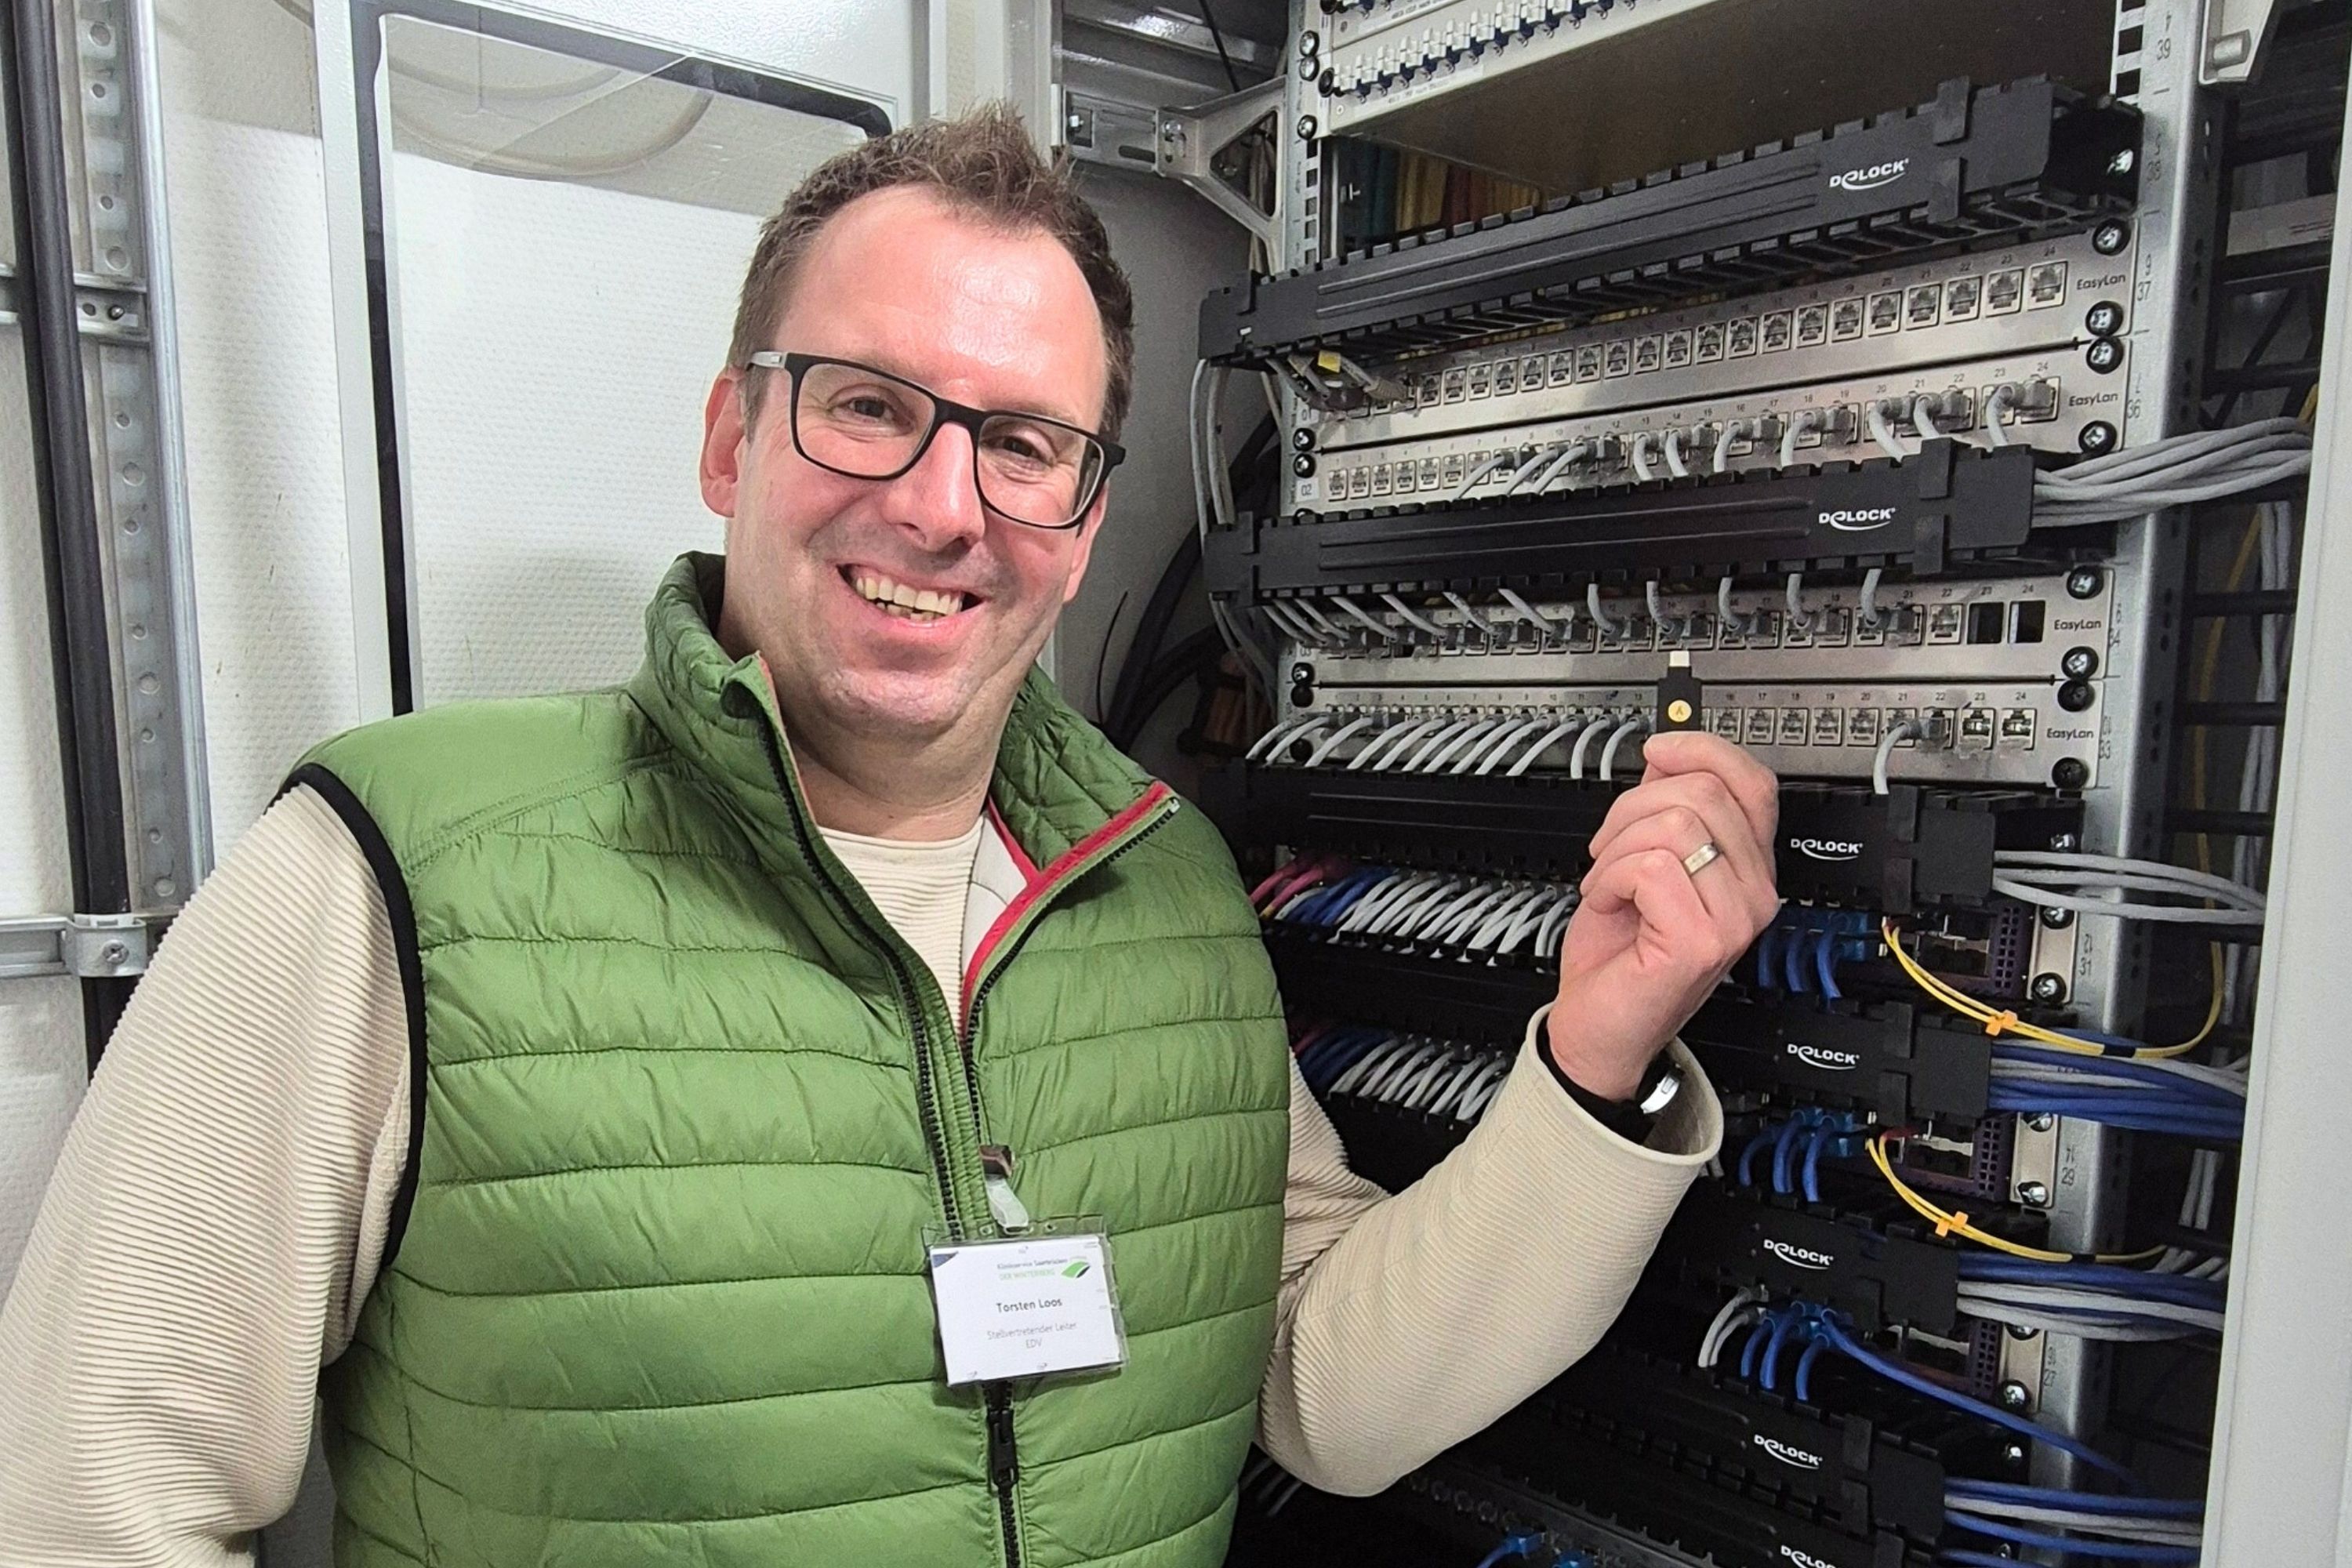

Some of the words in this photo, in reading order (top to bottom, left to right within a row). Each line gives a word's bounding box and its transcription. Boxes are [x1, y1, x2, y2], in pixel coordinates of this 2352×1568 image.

[2076, 274, 2126, 290] EasyLan
[2136, 280, 2152, 302] 37
[1915, 378, 1925, 388] 21
[1953, 373, 1965, 383] 22
[1994, 368, 2006, 378] 23
[2037, 361, 2049, 372] 24
[2068, 391, 2119, 408] EasyLan
[2022, 584, 2034, 593] 24
[2054, 619, 2102, 631] EasyLan
[1860, 692, 1871, 701] 20
[1897, 692, 1907, 701] 21
[1935, 692, 1946, 701] 22
[1974, 692, 1986, 701] 23
[2015, 691, 2027, 701] 24
[2046, 728, 2094, 741] EasyLan
[2078, 956, 2092, 977] 31
[996, 1301, 1036, 1313] Torsten
[1038, 1298, 1063, 1308] Loos
[1025, 1338, 1043, 1348] EDV
